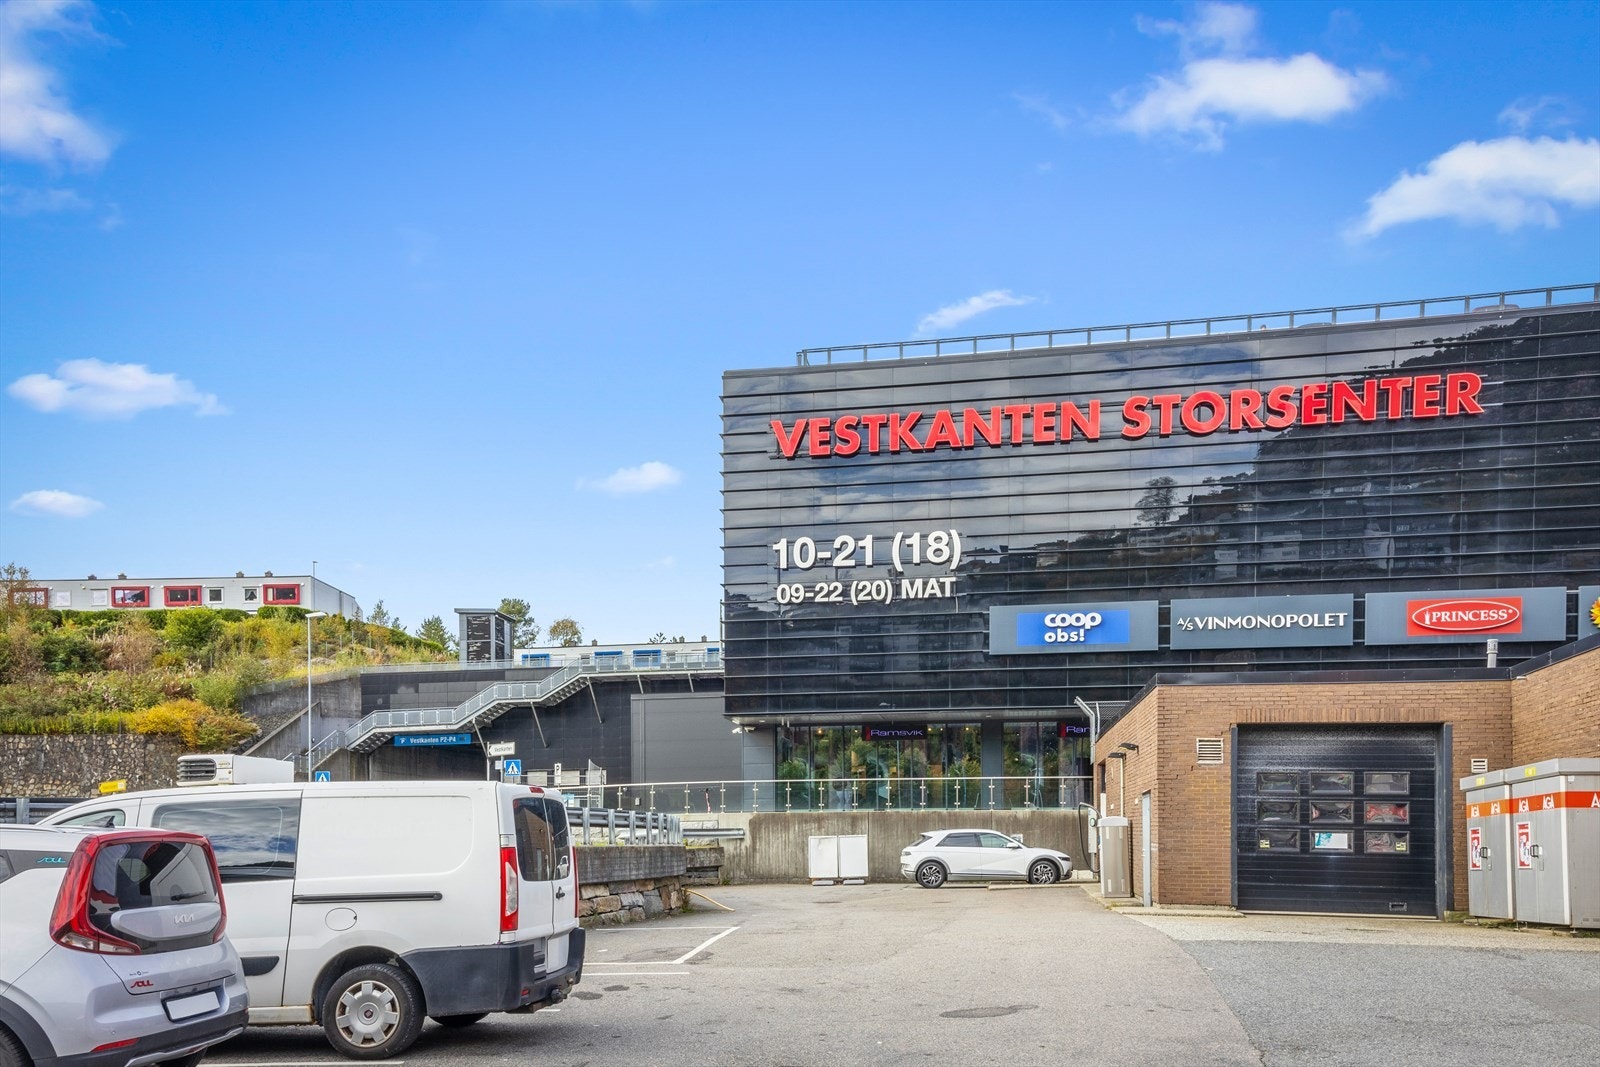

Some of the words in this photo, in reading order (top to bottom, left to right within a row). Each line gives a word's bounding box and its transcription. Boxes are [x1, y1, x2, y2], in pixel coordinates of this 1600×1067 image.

[771, 400, 1101, 458] VESTKANTEN
[1121, 371, 1485, 438] STORSENTER
[773, 534, 874, 570] 10-21
[892, 529, 962, 572] (18)
[776, 582, 844, 604] 09-22
[851, 579, 893, 606] (20)
[901, 577, 957, 600] MAT
[1044, 612, 1102, 630] coop
[1194, 612, 1348, 630] VINMONOPOLET
[1431, 608, 1508, 623] PRINCESS
[1044, 628, 1085, 643] obs!
[409, 736, 440, 744] Vestkanten
[870, 729, 923, 737] Ramsvik
